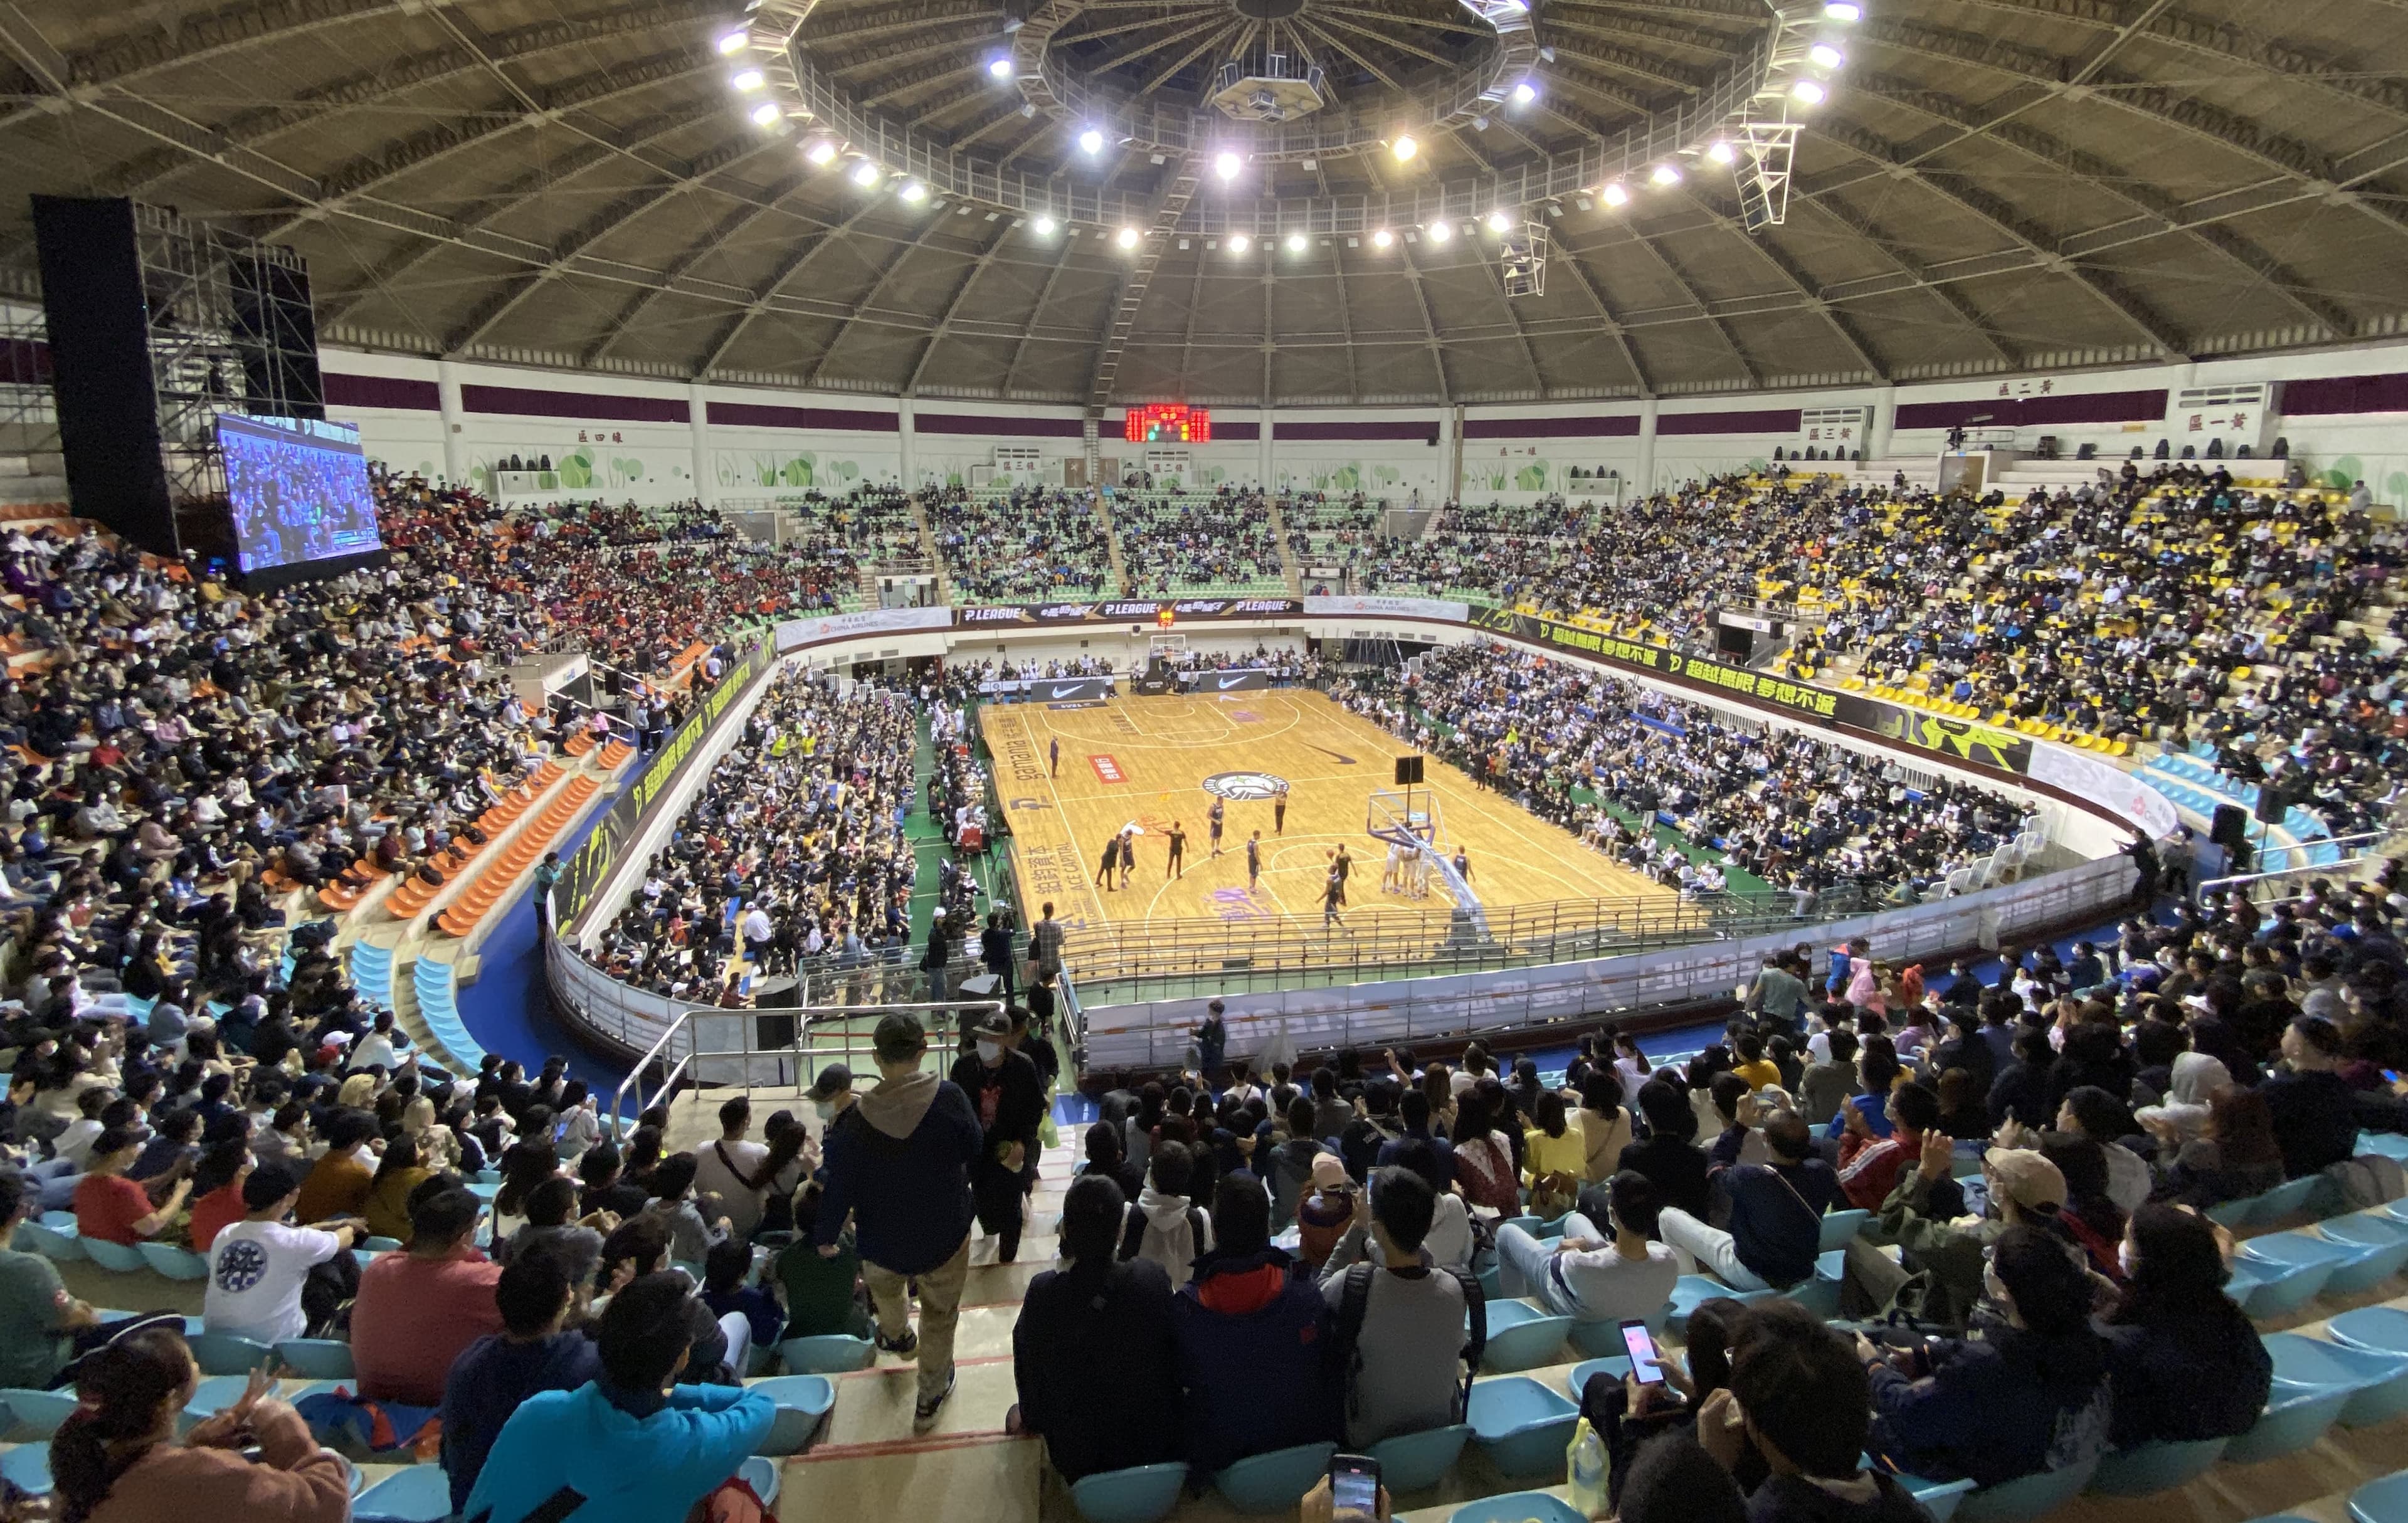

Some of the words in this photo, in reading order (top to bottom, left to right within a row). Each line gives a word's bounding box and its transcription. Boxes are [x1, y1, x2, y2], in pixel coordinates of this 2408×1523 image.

[1686, 659, 1756, 693] 超越無限
[1006, 740, 1046, 781] gamania
[1056, 841, 1079, 873] CAPITAL
[1067, 873, 1088, 891] ACE
